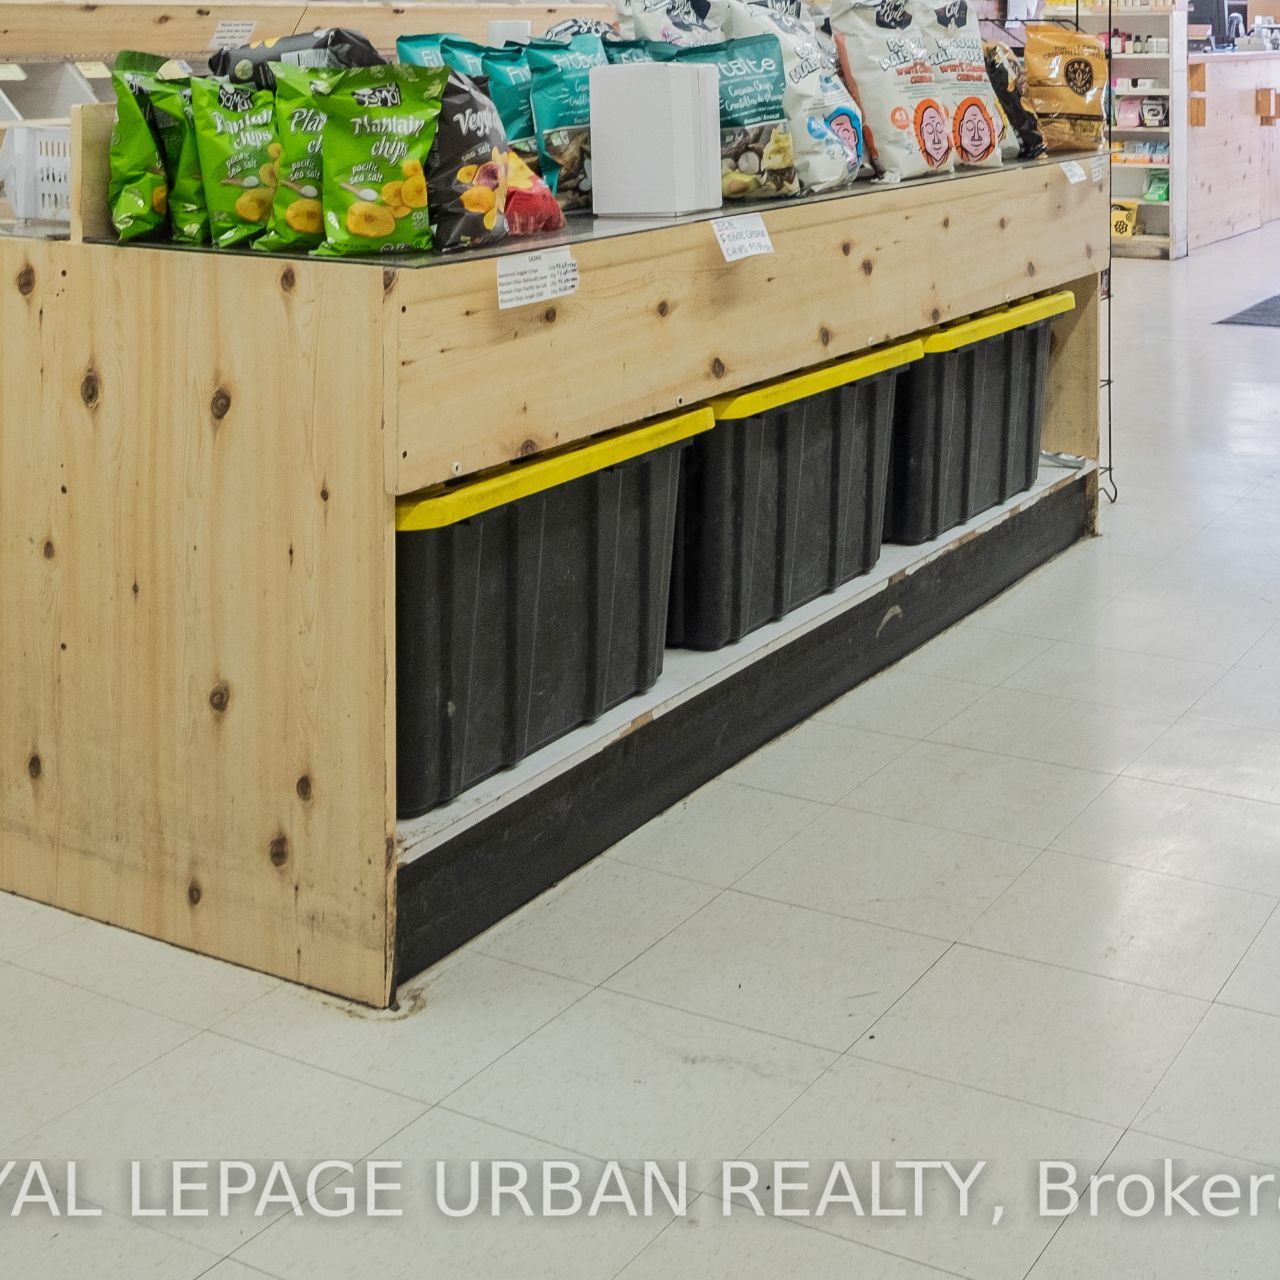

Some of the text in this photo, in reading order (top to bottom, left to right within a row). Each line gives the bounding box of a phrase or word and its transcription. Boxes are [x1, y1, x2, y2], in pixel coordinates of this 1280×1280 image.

[372, 136, 410, 166] chips
[477, 142, 491, 154] salt
[243, 158, 257, 170] salt
[291, 159, 315, 171] pacific
[352, 161, 378, 174] pacific
[289, 169, 320, 180] sea salt
[349, 172, 384, 185] sea salt
